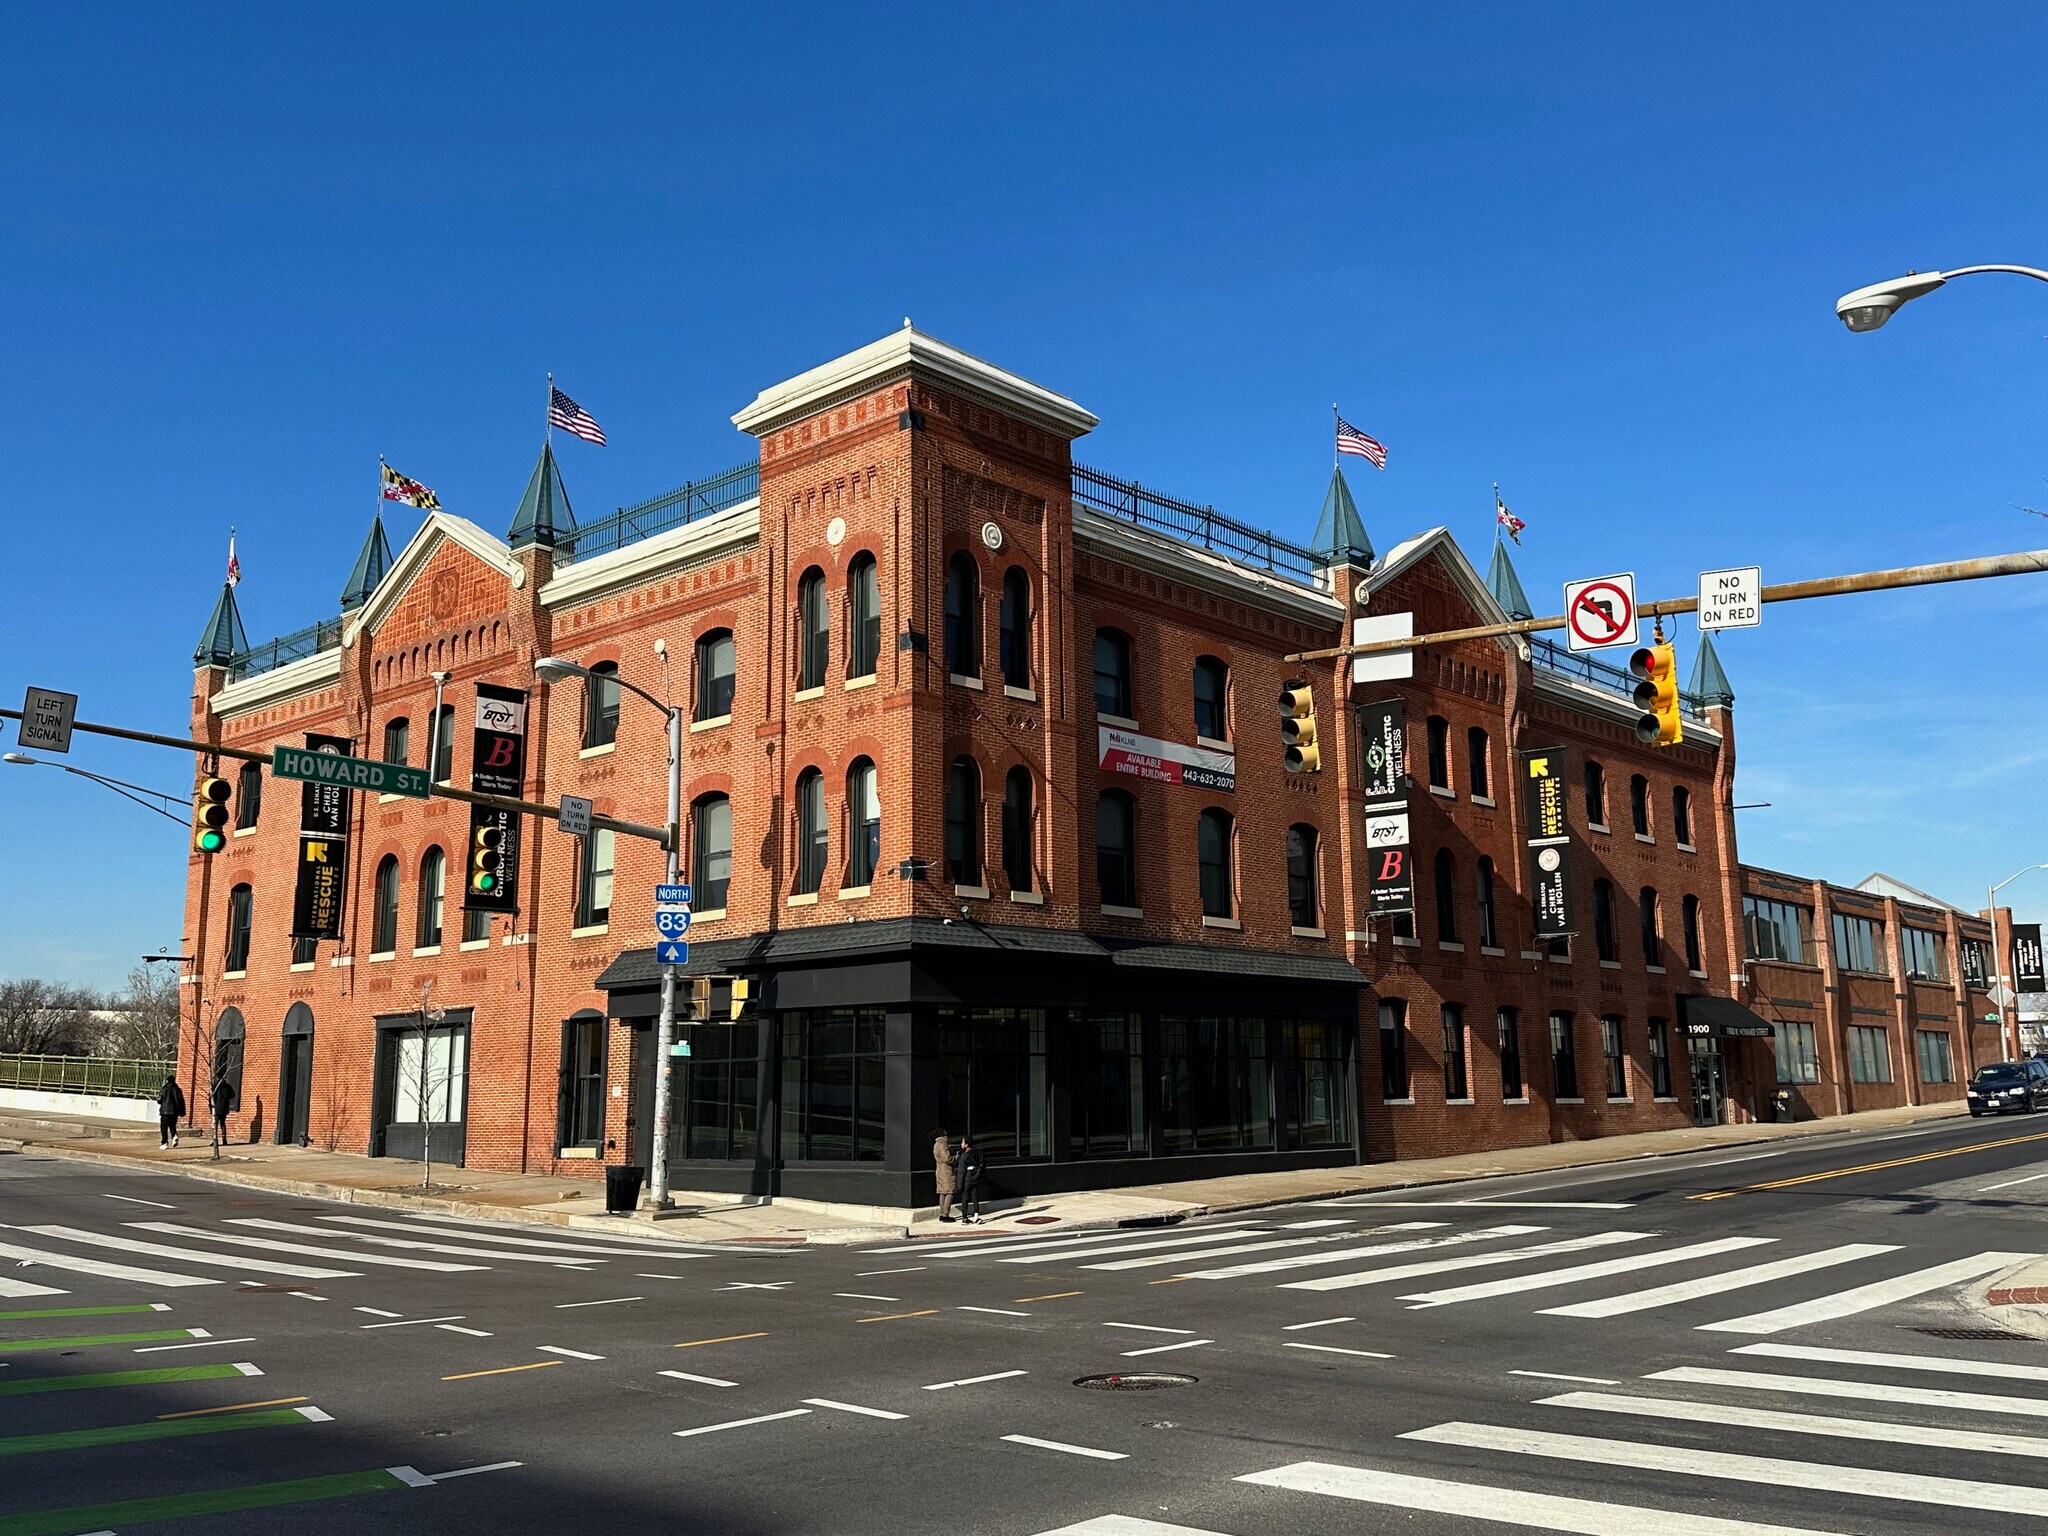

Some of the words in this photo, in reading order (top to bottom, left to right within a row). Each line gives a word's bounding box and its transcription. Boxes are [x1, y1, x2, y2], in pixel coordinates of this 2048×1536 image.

[1719, 576, 1740, 589] NO
[1712, 592, 1747, 606] TURN
[1704, 610, 1721, 623] ON
[1729, 607, 1755, 620] RED
[36, 697, 65, 712] LEFT
[35, 713, 62, 728] TURN
[482, 710, 514, 723] BTST
[27, 727, 64, 743] SIGNAL
[484, 737, 515, 767] B
[1126, 753, 1162, 769] AVAILABLE
[1383, 714, 1396, 794] CHIROPRACTIC
[1393, 728, 1404, 778] WELLNESS
[284, 753, 385, 786] HOWARD
[397, 774, 423, 791] ST.
[480, 773, 495, 781] Better
[495, 775, 519, 784] Tomorrow
[1116, 762, 1139, 776] ENTIRE
[1141, 767, 1172, 782] BUILDING
[1182, 769, 1235, 789] 443-632-2070
[332, 786, 340, 805] HOL
[497, 782, 512, 791] Today
[322, 786, 332, 814] CHRIS
[570, 801, 583, 809] NO
[1539, 779, 1548, 836] INTERNATIONAL
[1544, 778, 1557, 836] RESCUE
[330, 807, 339, 828] VAN
[566, 810, 585, 820] TURN
[561, 820, 572, 828] ON
[574, 821, 588, 831] RED
[1372, 826, 1400, 838] BTST
[505, 829, 516, 882] WELLNESS
[1377, 850, 1403, 880] B
[310, 865, 321, 929] INTERNATIONAL
[316, 866, 333, 929] RESCUE
[328, 866, 339, 930] COMMITTEE
[658, 888, 689, 900] NORTH
[1554, 872, 1564, 905] HOLLEN
[1548, 888, 1557, 914] CHRIS
[658, 913, 688, 931] 83
[1556, 907, 1566, 927] VAN
[1688, 1024, 1710, 1034] 1900
